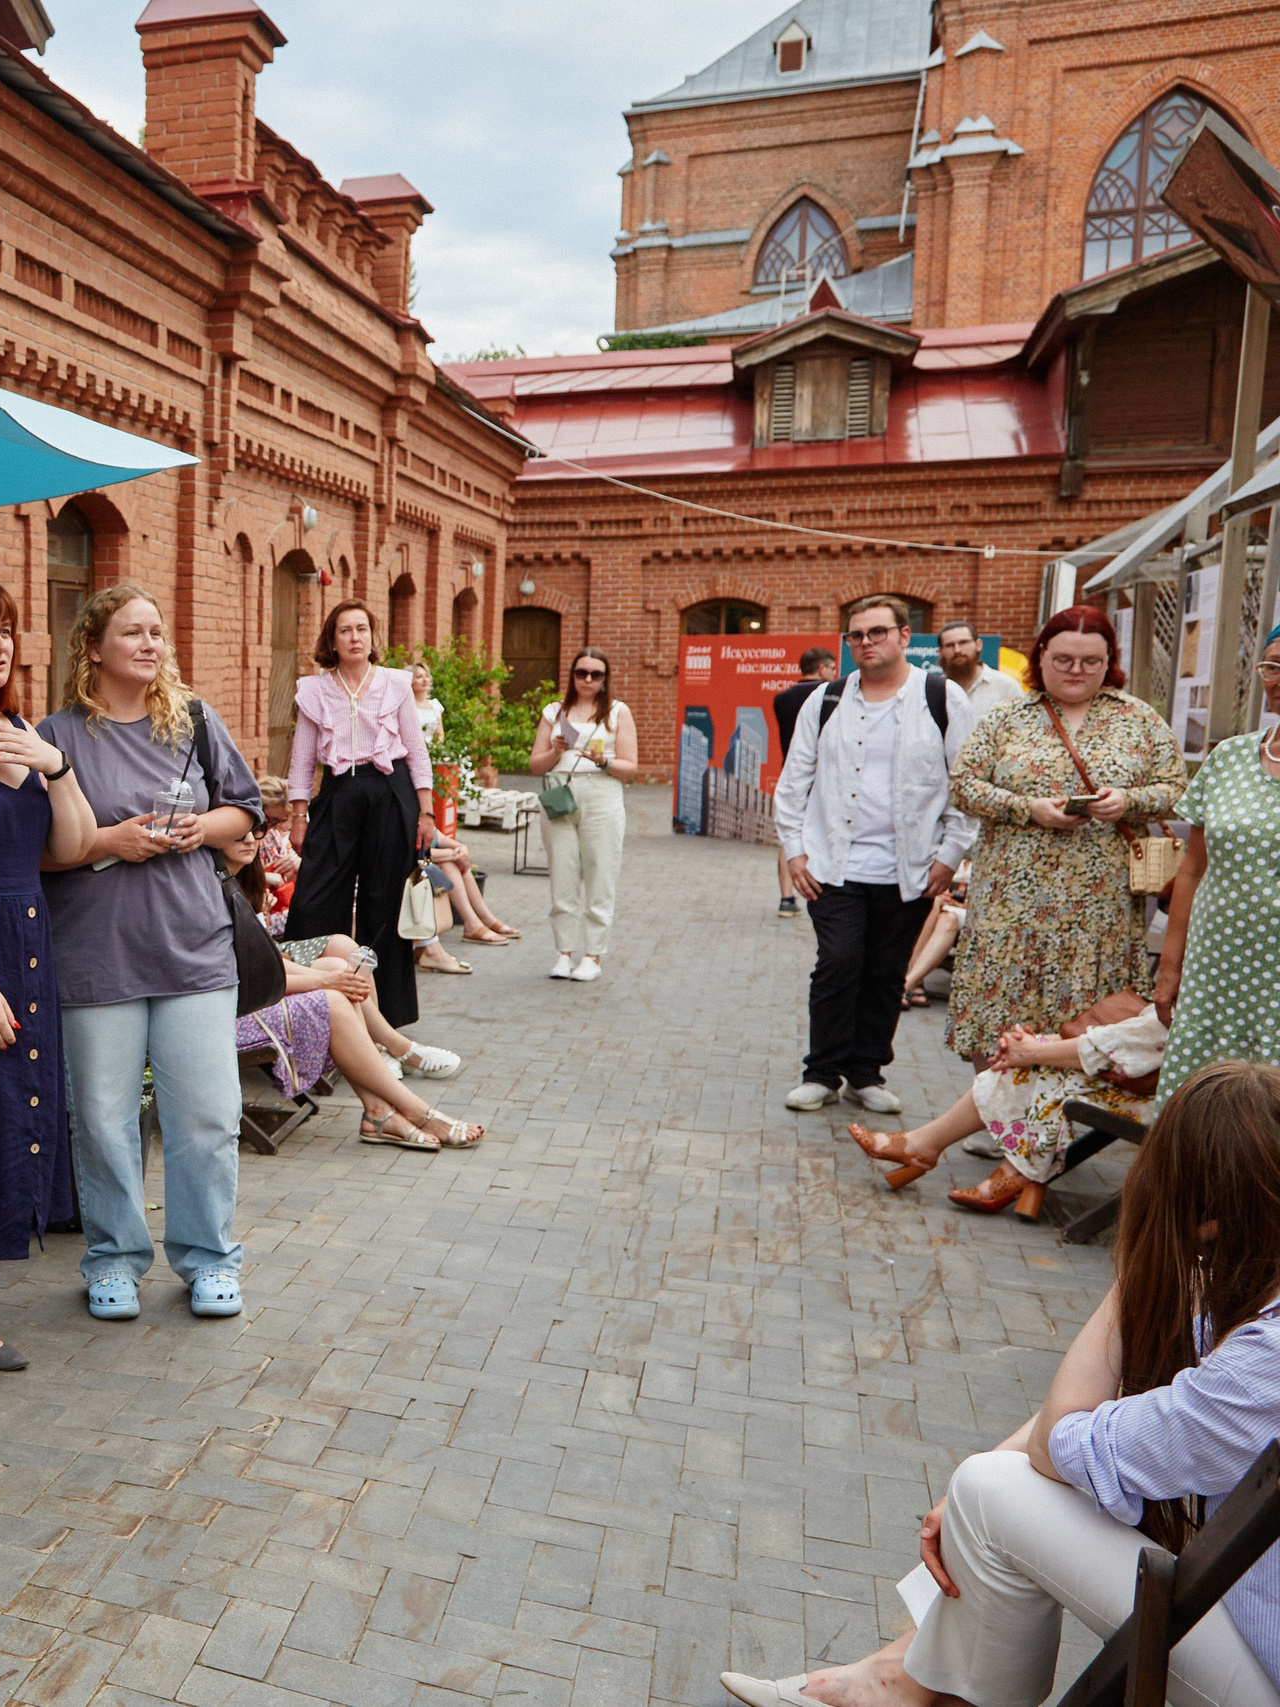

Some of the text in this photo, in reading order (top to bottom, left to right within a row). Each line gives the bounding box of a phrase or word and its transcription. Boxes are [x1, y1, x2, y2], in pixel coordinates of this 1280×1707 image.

[721, 645, 786, 660] Искусство
[904, 646, 939, 659] интерес
[736, 663, 802, 675] наслажда
[762, 680, 798, 691] насто
